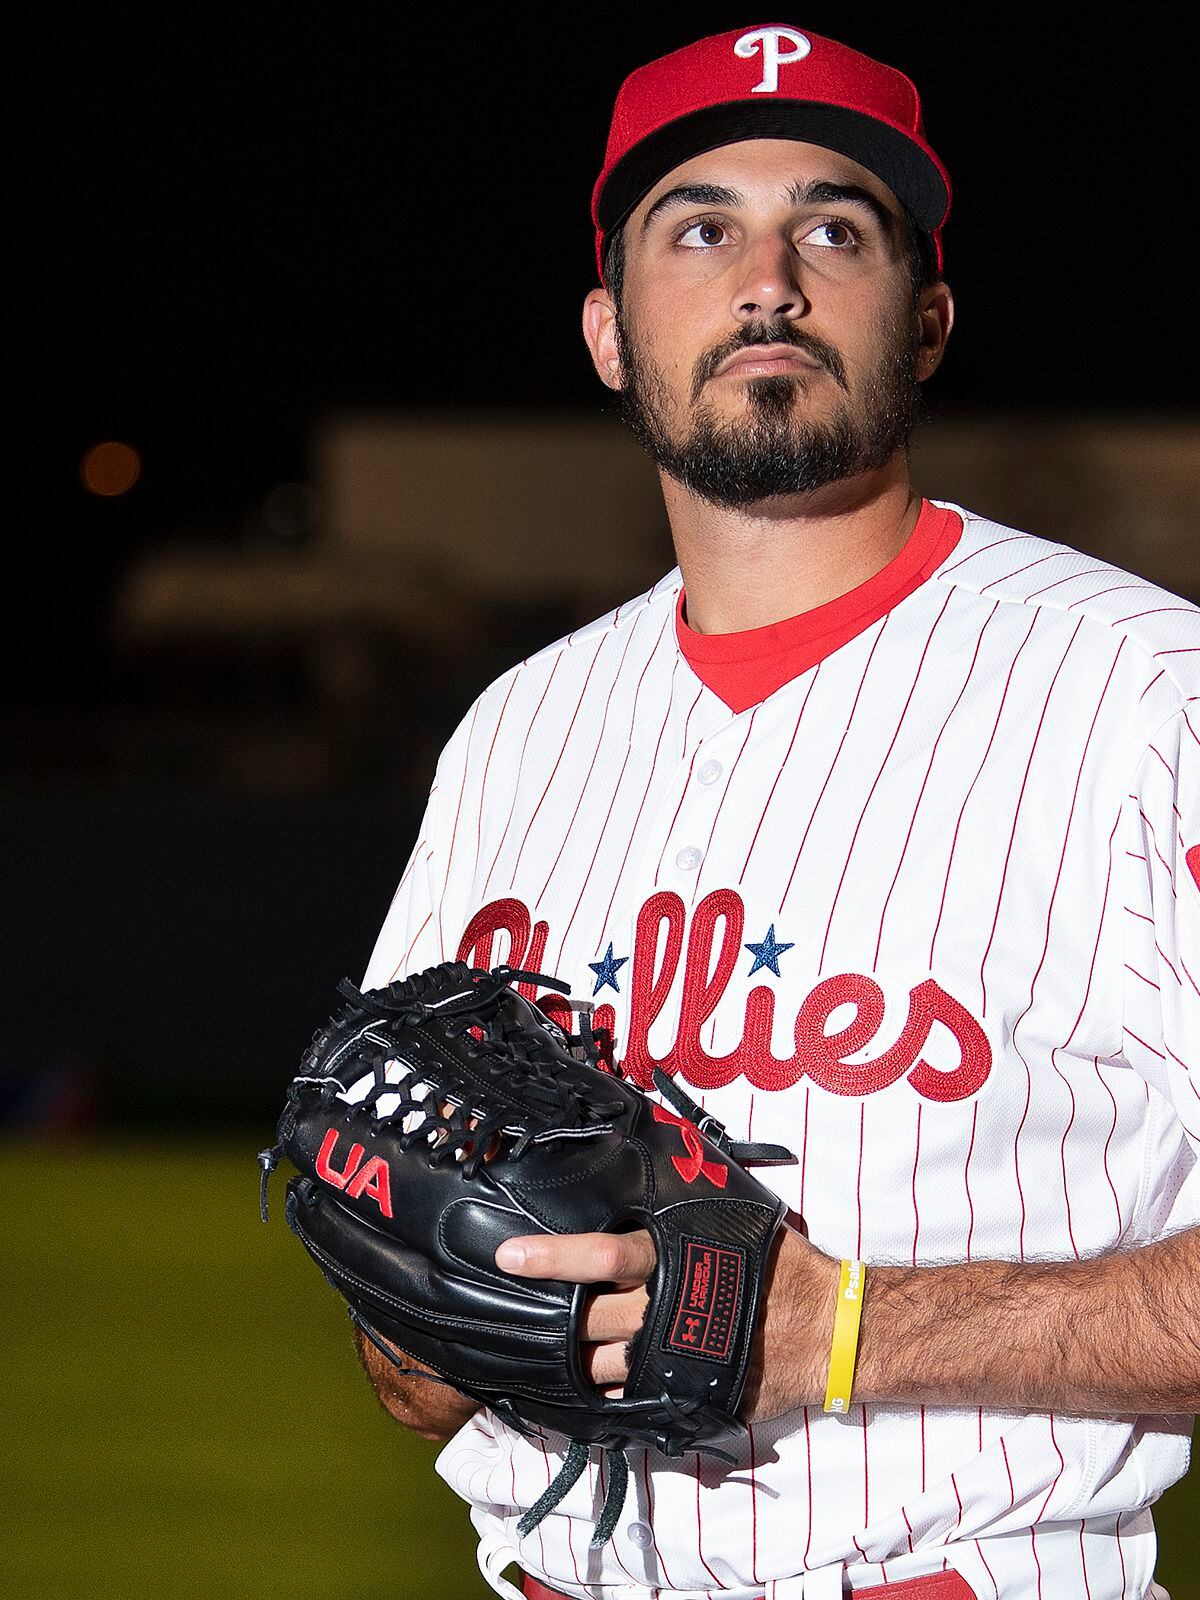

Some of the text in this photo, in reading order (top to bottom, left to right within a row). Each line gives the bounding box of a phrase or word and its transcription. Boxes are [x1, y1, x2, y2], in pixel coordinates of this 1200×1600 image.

[734, 26, 811, 93] P
[316, 1128, 393, 1218] UA
[689, 1262, 703, 1307] UNDER
[697, 1252, 712, 1310] ARMOUR
